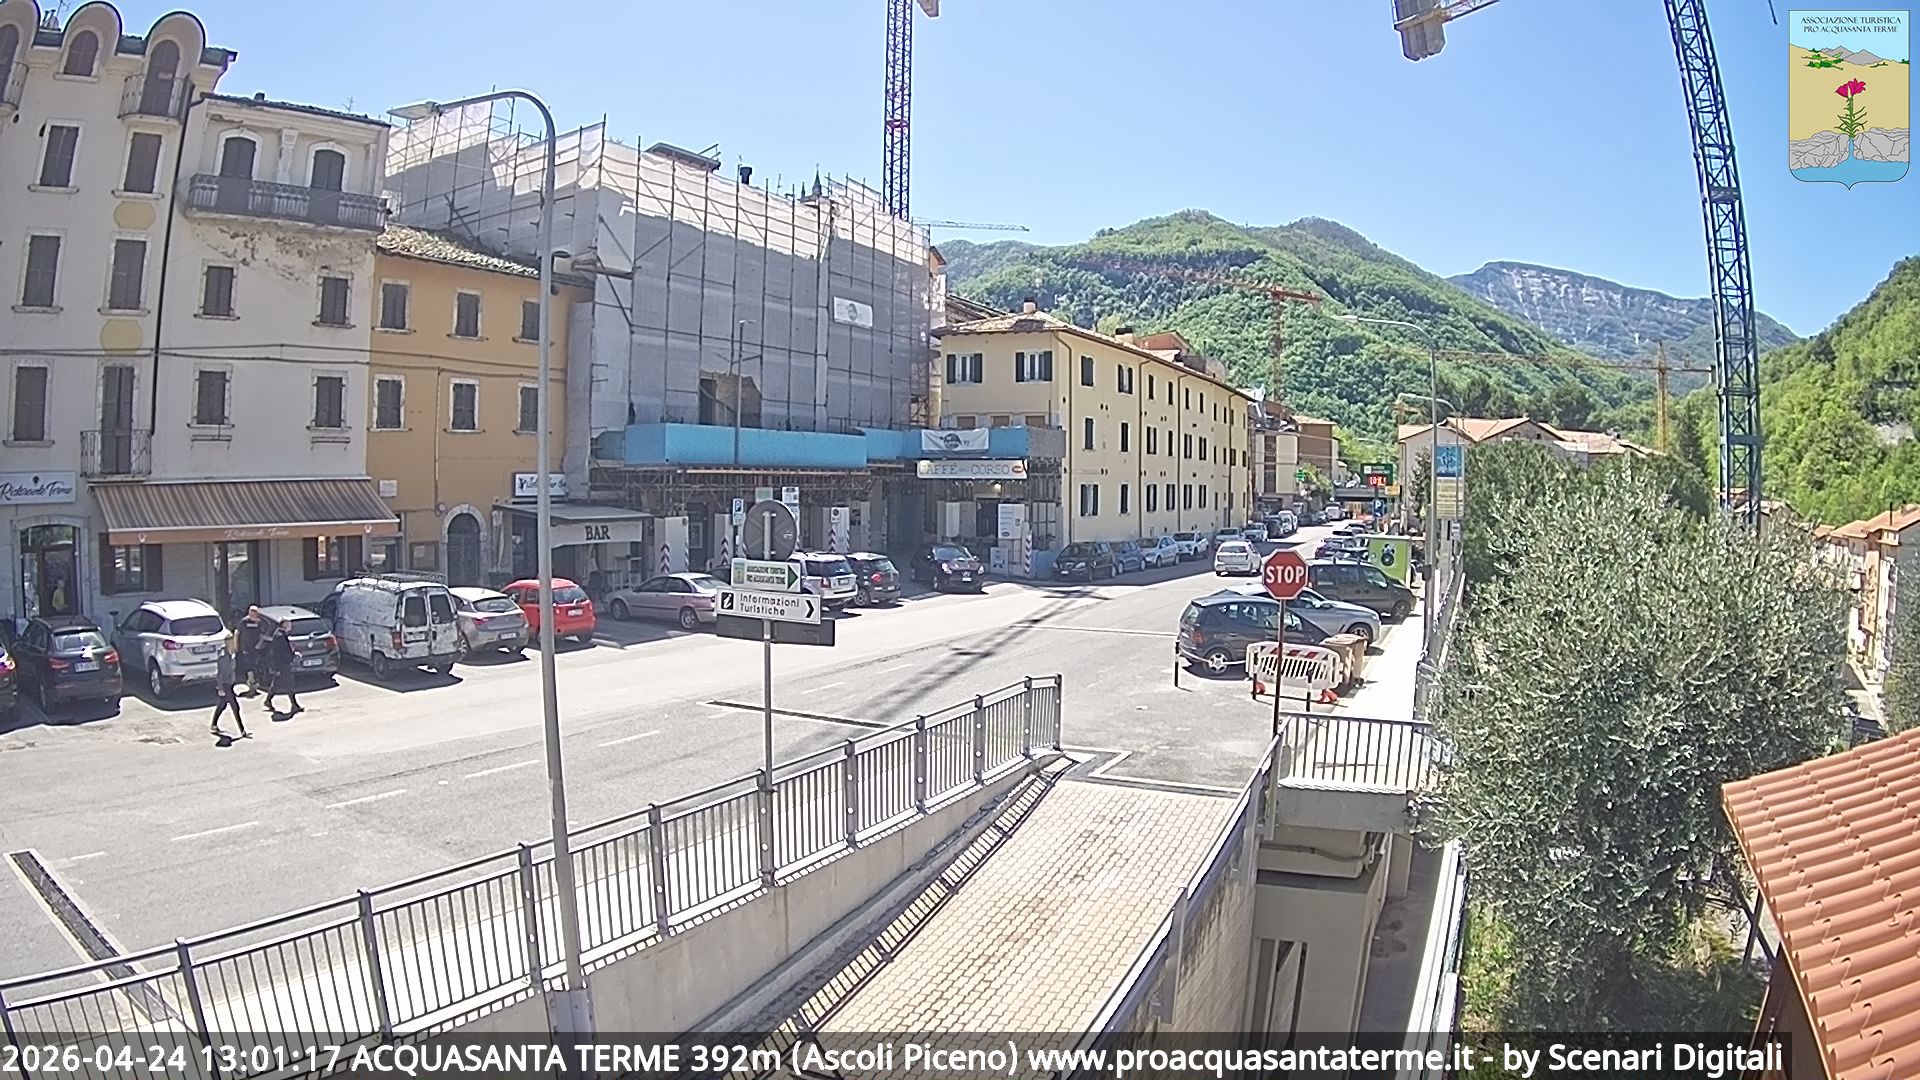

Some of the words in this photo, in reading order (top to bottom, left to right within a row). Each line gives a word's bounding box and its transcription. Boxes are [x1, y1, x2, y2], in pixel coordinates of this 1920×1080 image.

[970, 464, 1010, 475] CORSO
[585, 525, 611, 541] BAR
[1266, 565, 1305, 584] STOP
[740, 593, 800, 607] Informazioni
[740, 603, 785, 616] Turistiche
